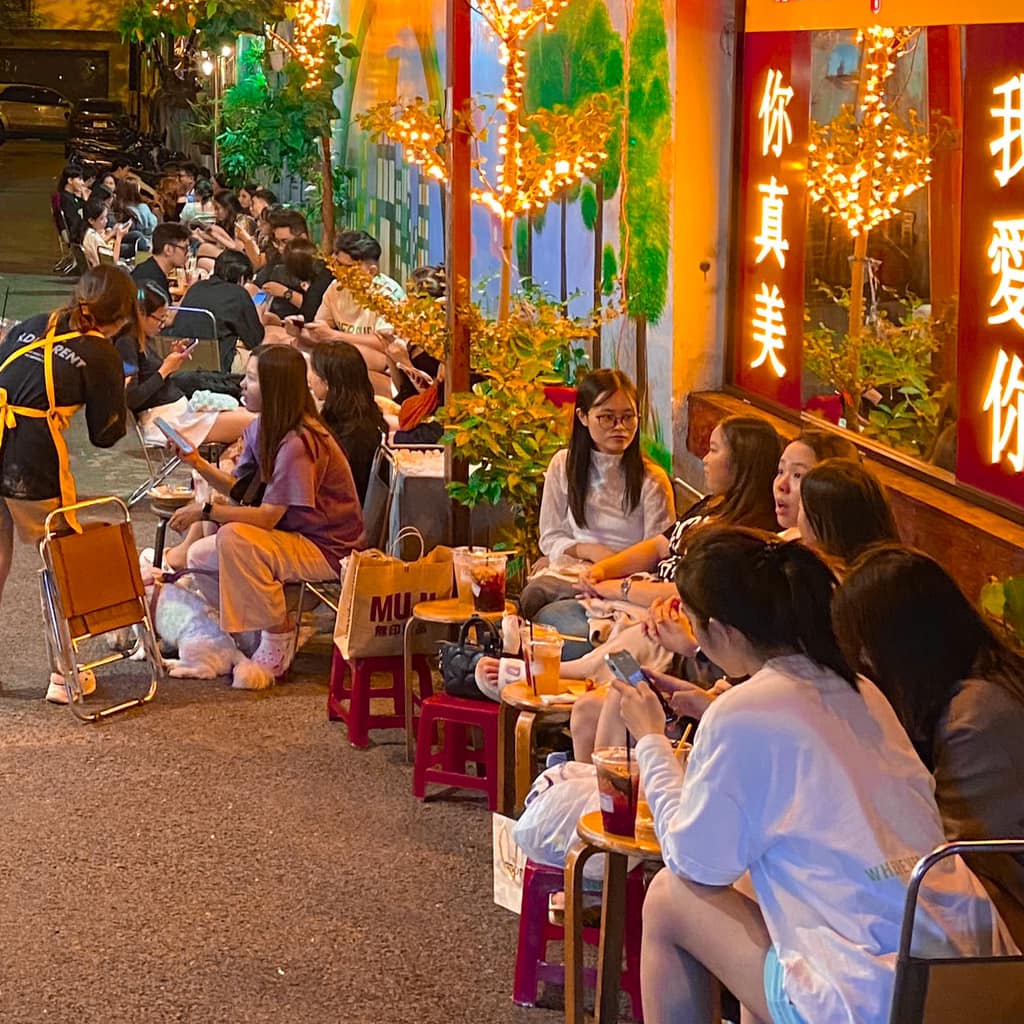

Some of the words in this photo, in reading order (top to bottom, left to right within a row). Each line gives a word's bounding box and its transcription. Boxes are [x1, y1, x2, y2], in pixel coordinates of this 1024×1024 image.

[749, 67, 795, 379] 你真美
[369, 591, 437, 623] MU
